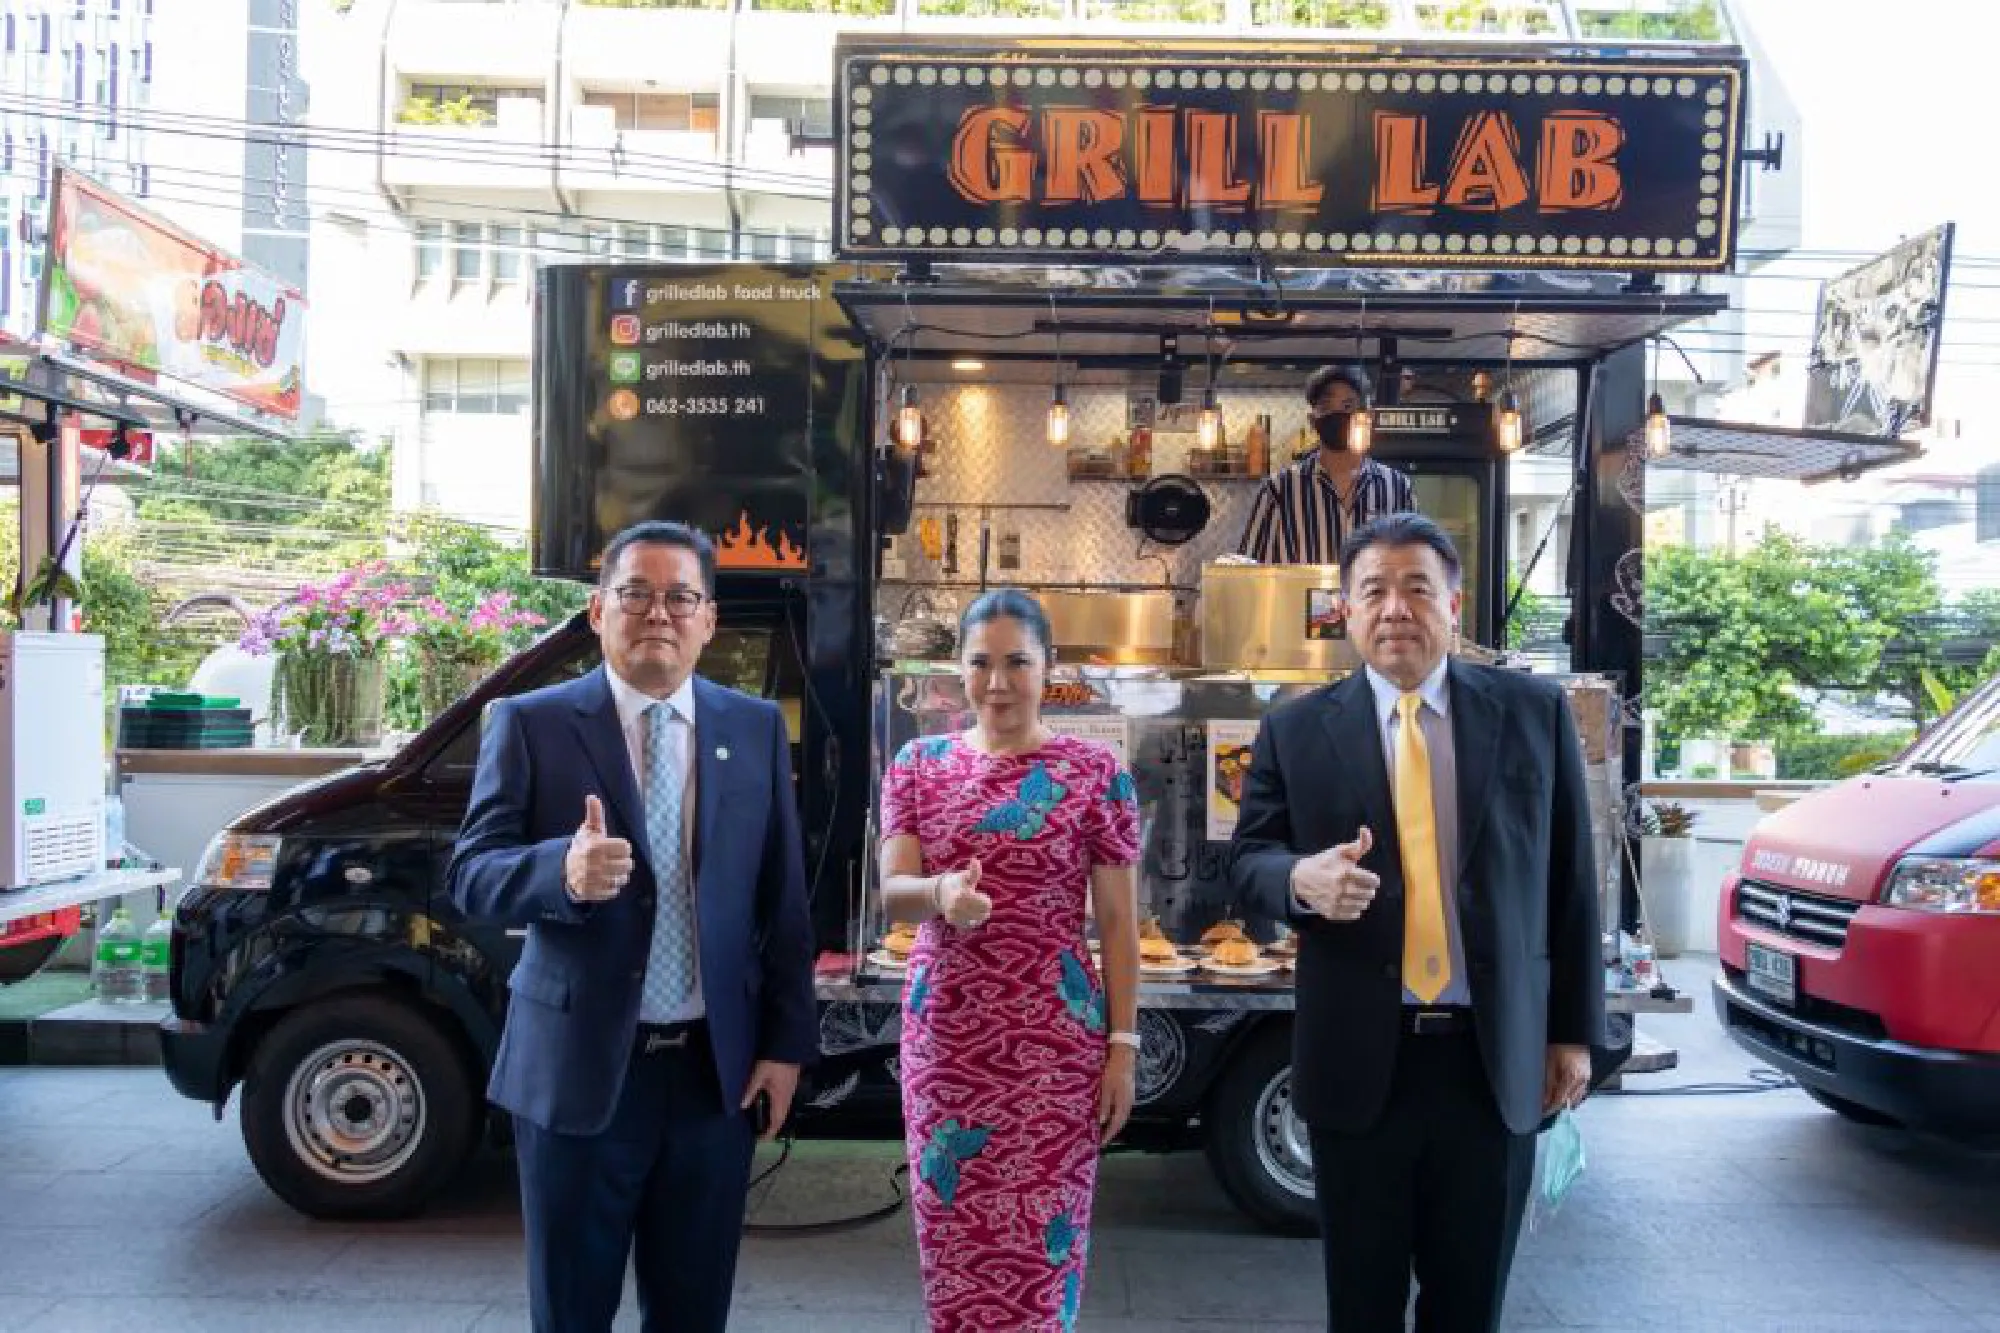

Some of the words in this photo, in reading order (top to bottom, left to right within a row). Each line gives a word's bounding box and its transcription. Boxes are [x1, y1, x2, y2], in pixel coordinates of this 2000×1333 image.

[947, 102, 1324, 214] GRILL
[1370, 109, 1627, 216] LAB
[734, 284, 773, 300] food
[779, 284, 821, 300] truck
